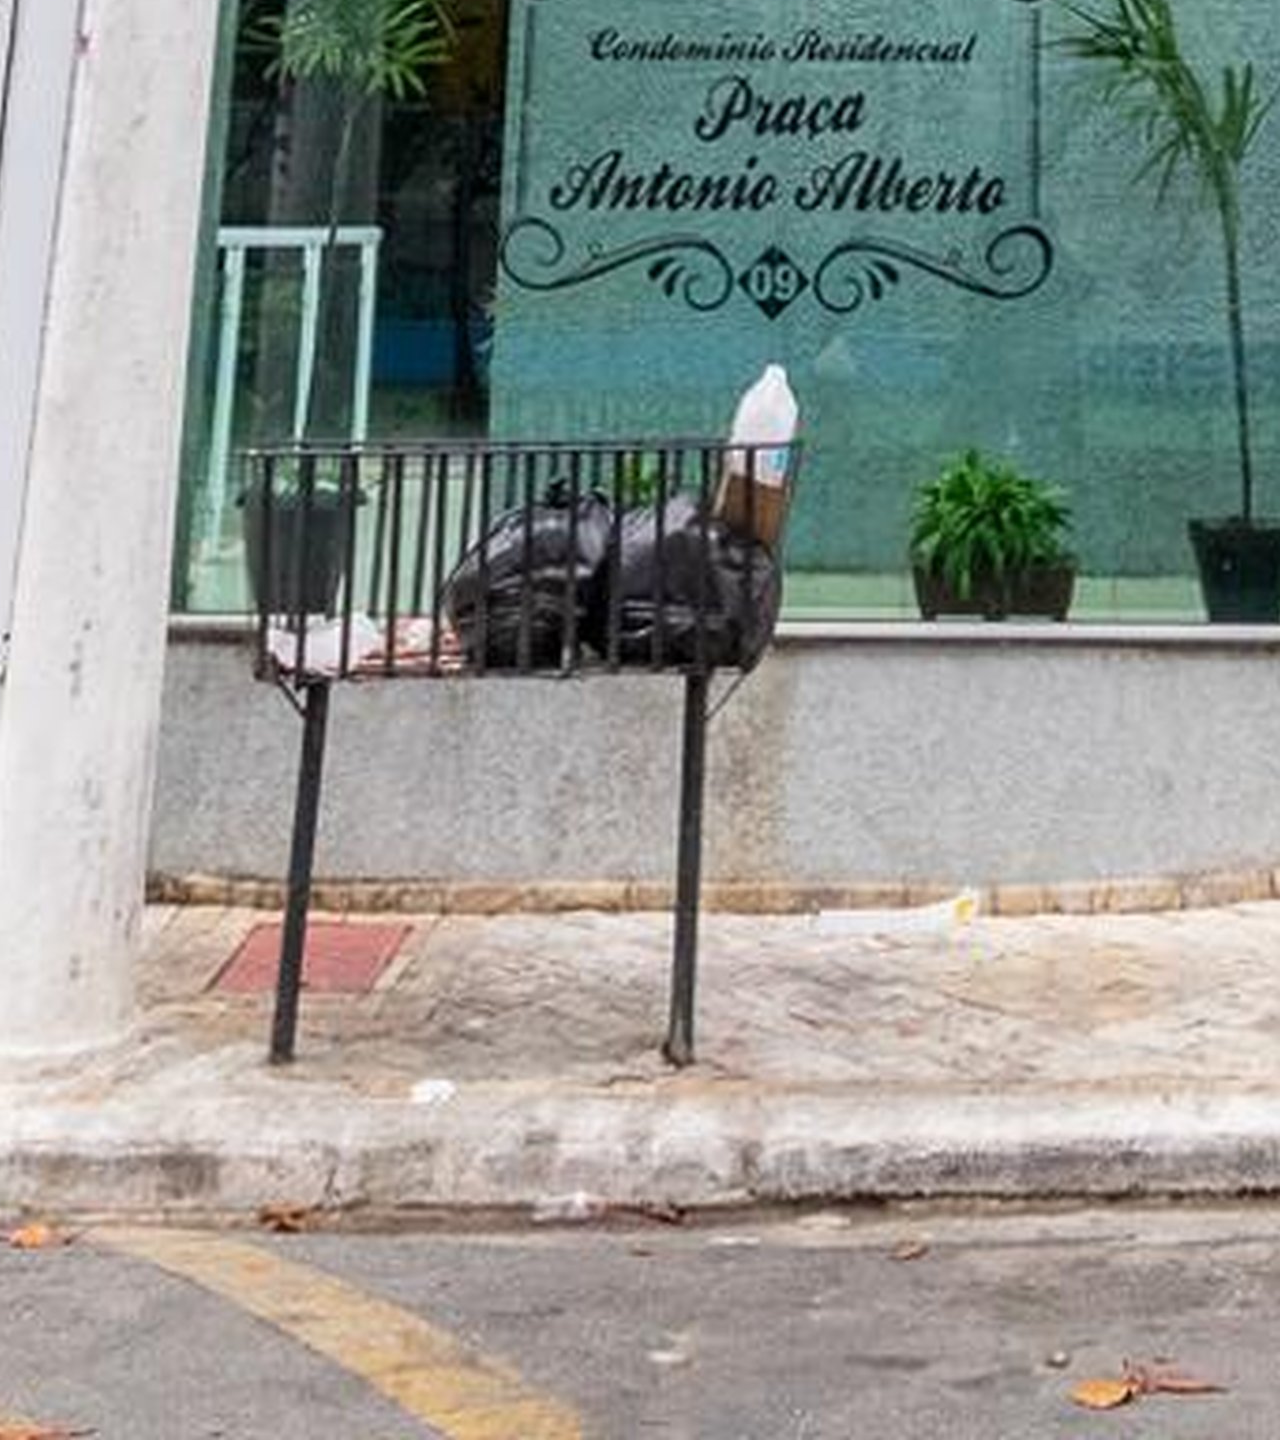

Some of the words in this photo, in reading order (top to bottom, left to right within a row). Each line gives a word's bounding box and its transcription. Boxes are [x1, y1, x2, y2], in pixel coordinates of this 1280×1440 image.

[781, 28, 978, 64] Residencial
[694, 75, 865, 142] Praça
[549, 150, 777, 211] Antonio
[795, 152, 1007, 213] Alberto
[748, 264, 799, 299] 09
